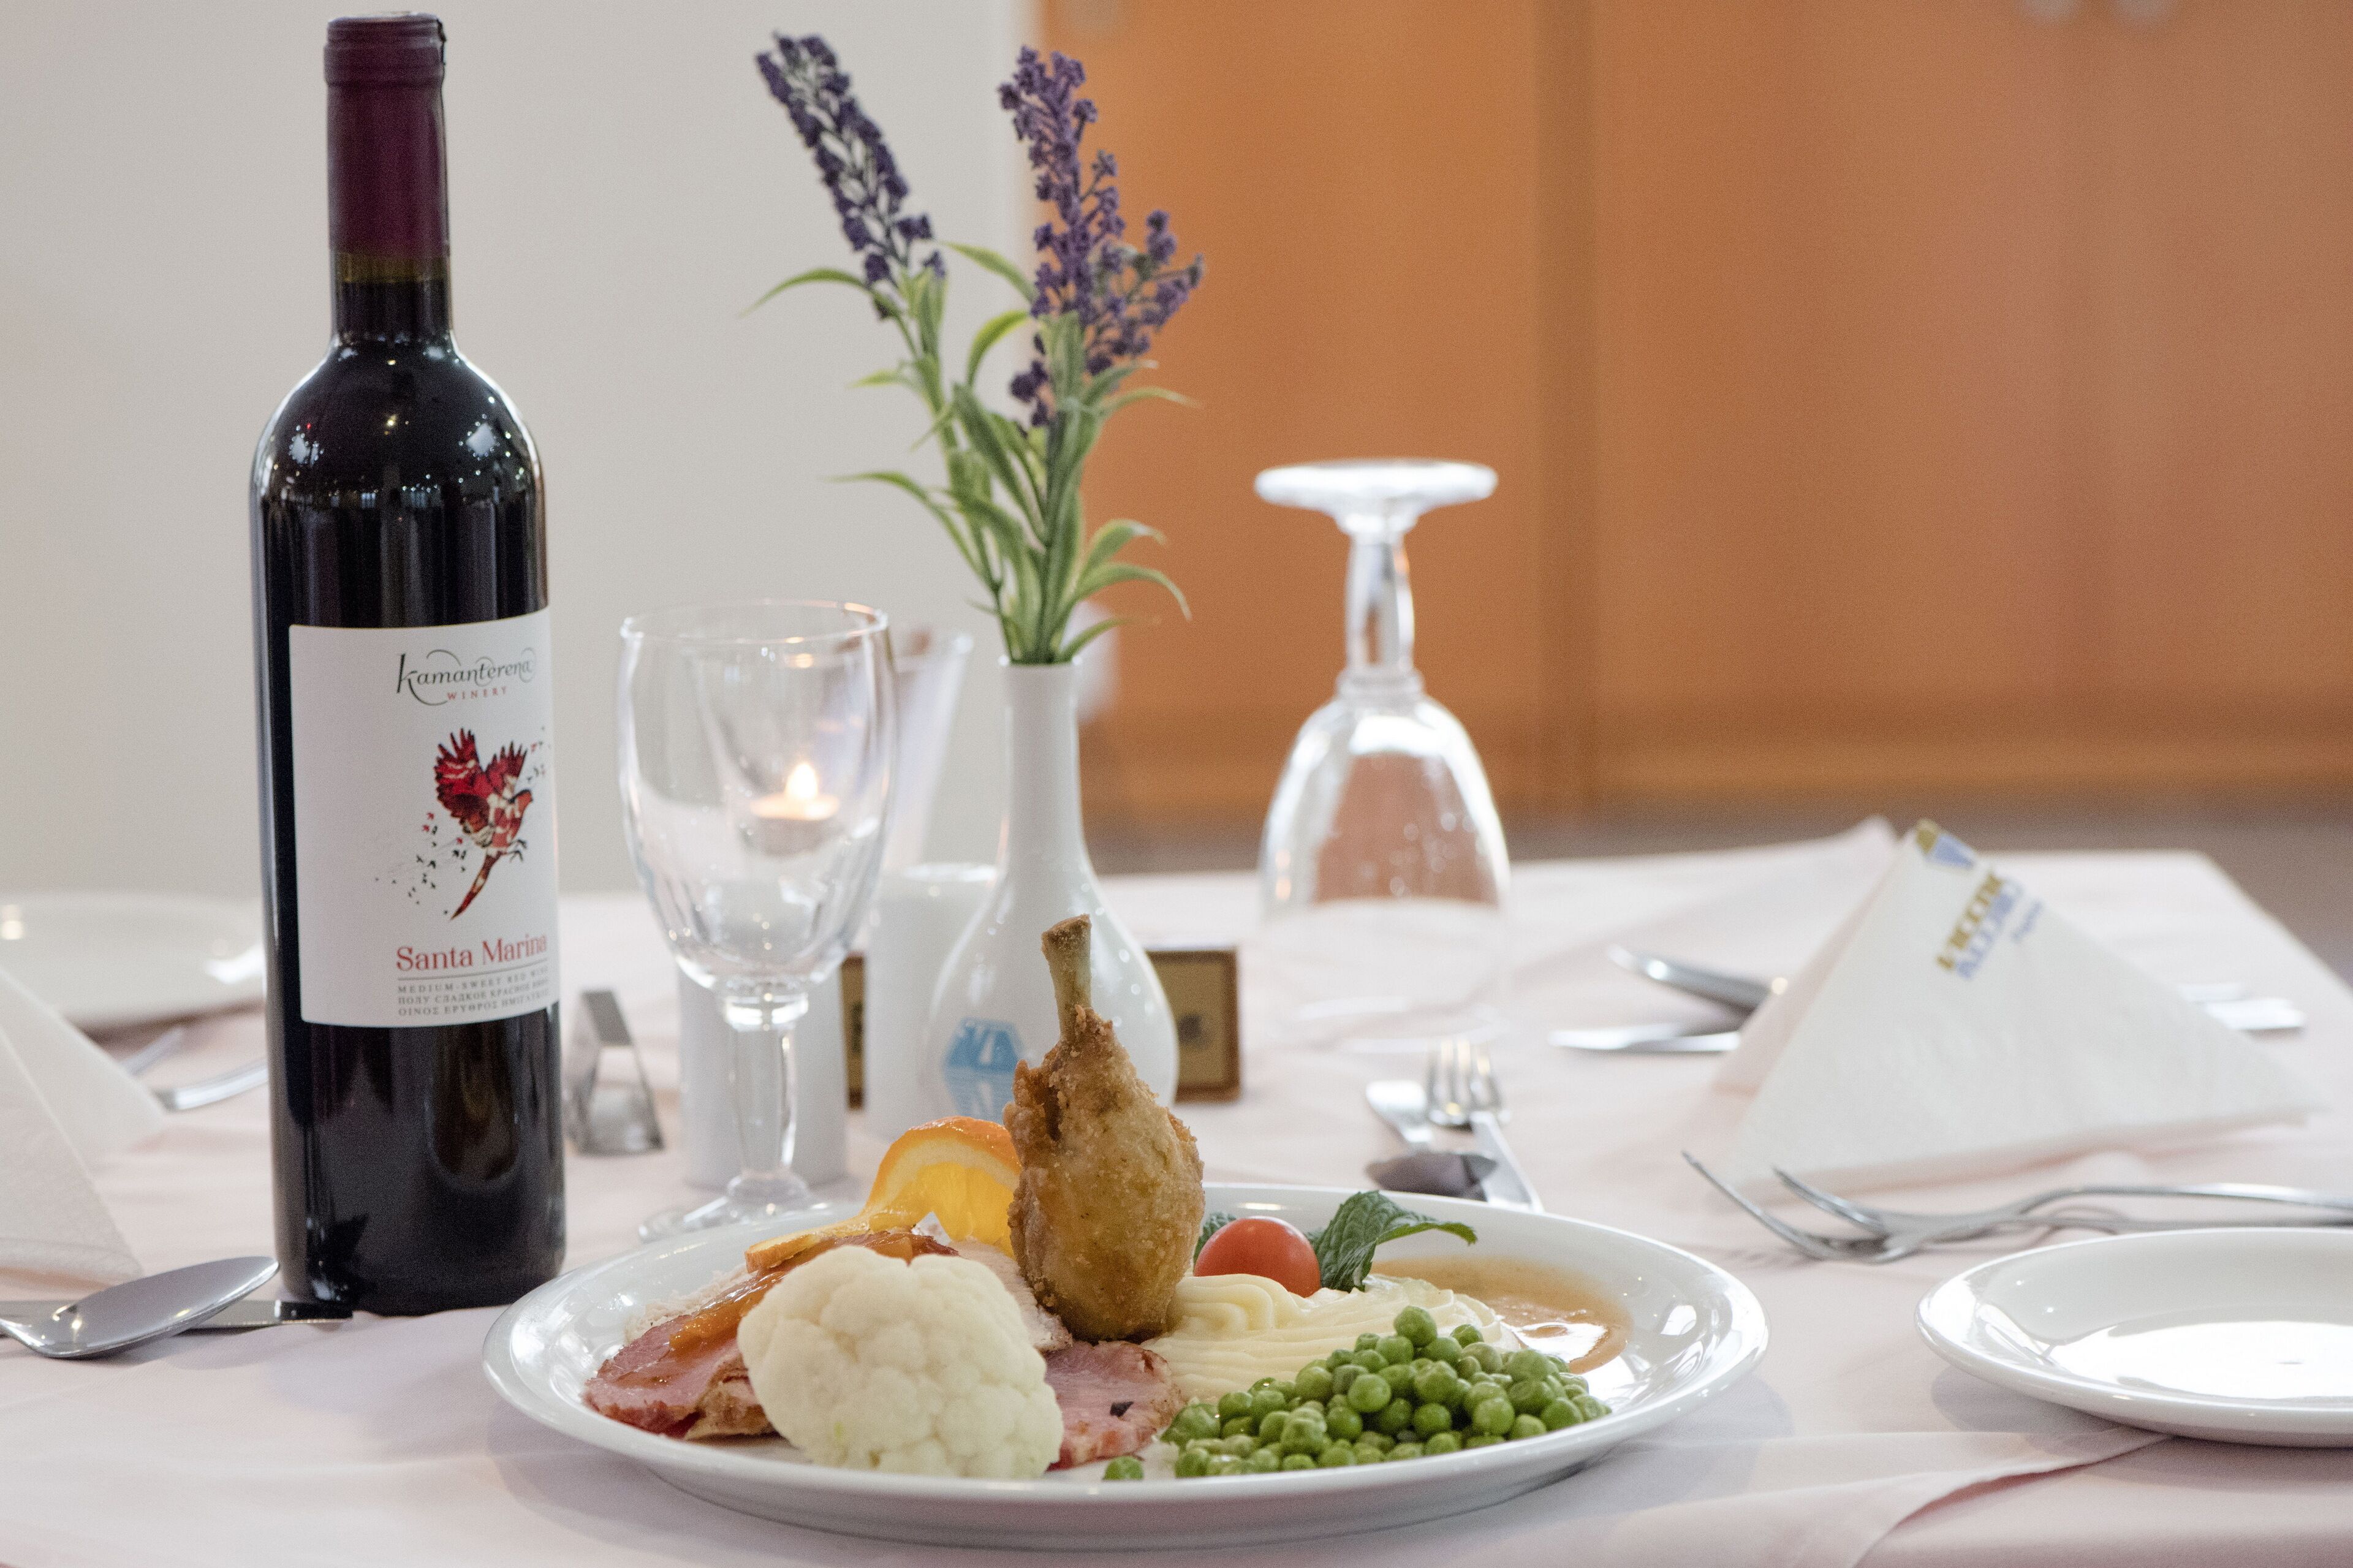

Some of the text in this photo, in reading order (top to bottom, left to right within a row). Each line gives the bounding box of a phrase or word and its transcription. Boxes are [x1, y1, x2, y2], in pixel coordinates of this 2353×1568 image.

[447, 686, 507, 700] WINERY
[396, 934, 547, 971] Santa Marina
[398, 983, 454, 993] MEDIUM
[461, 977, 501, 990] SWEET
[507, 972, 526, 983] RED
